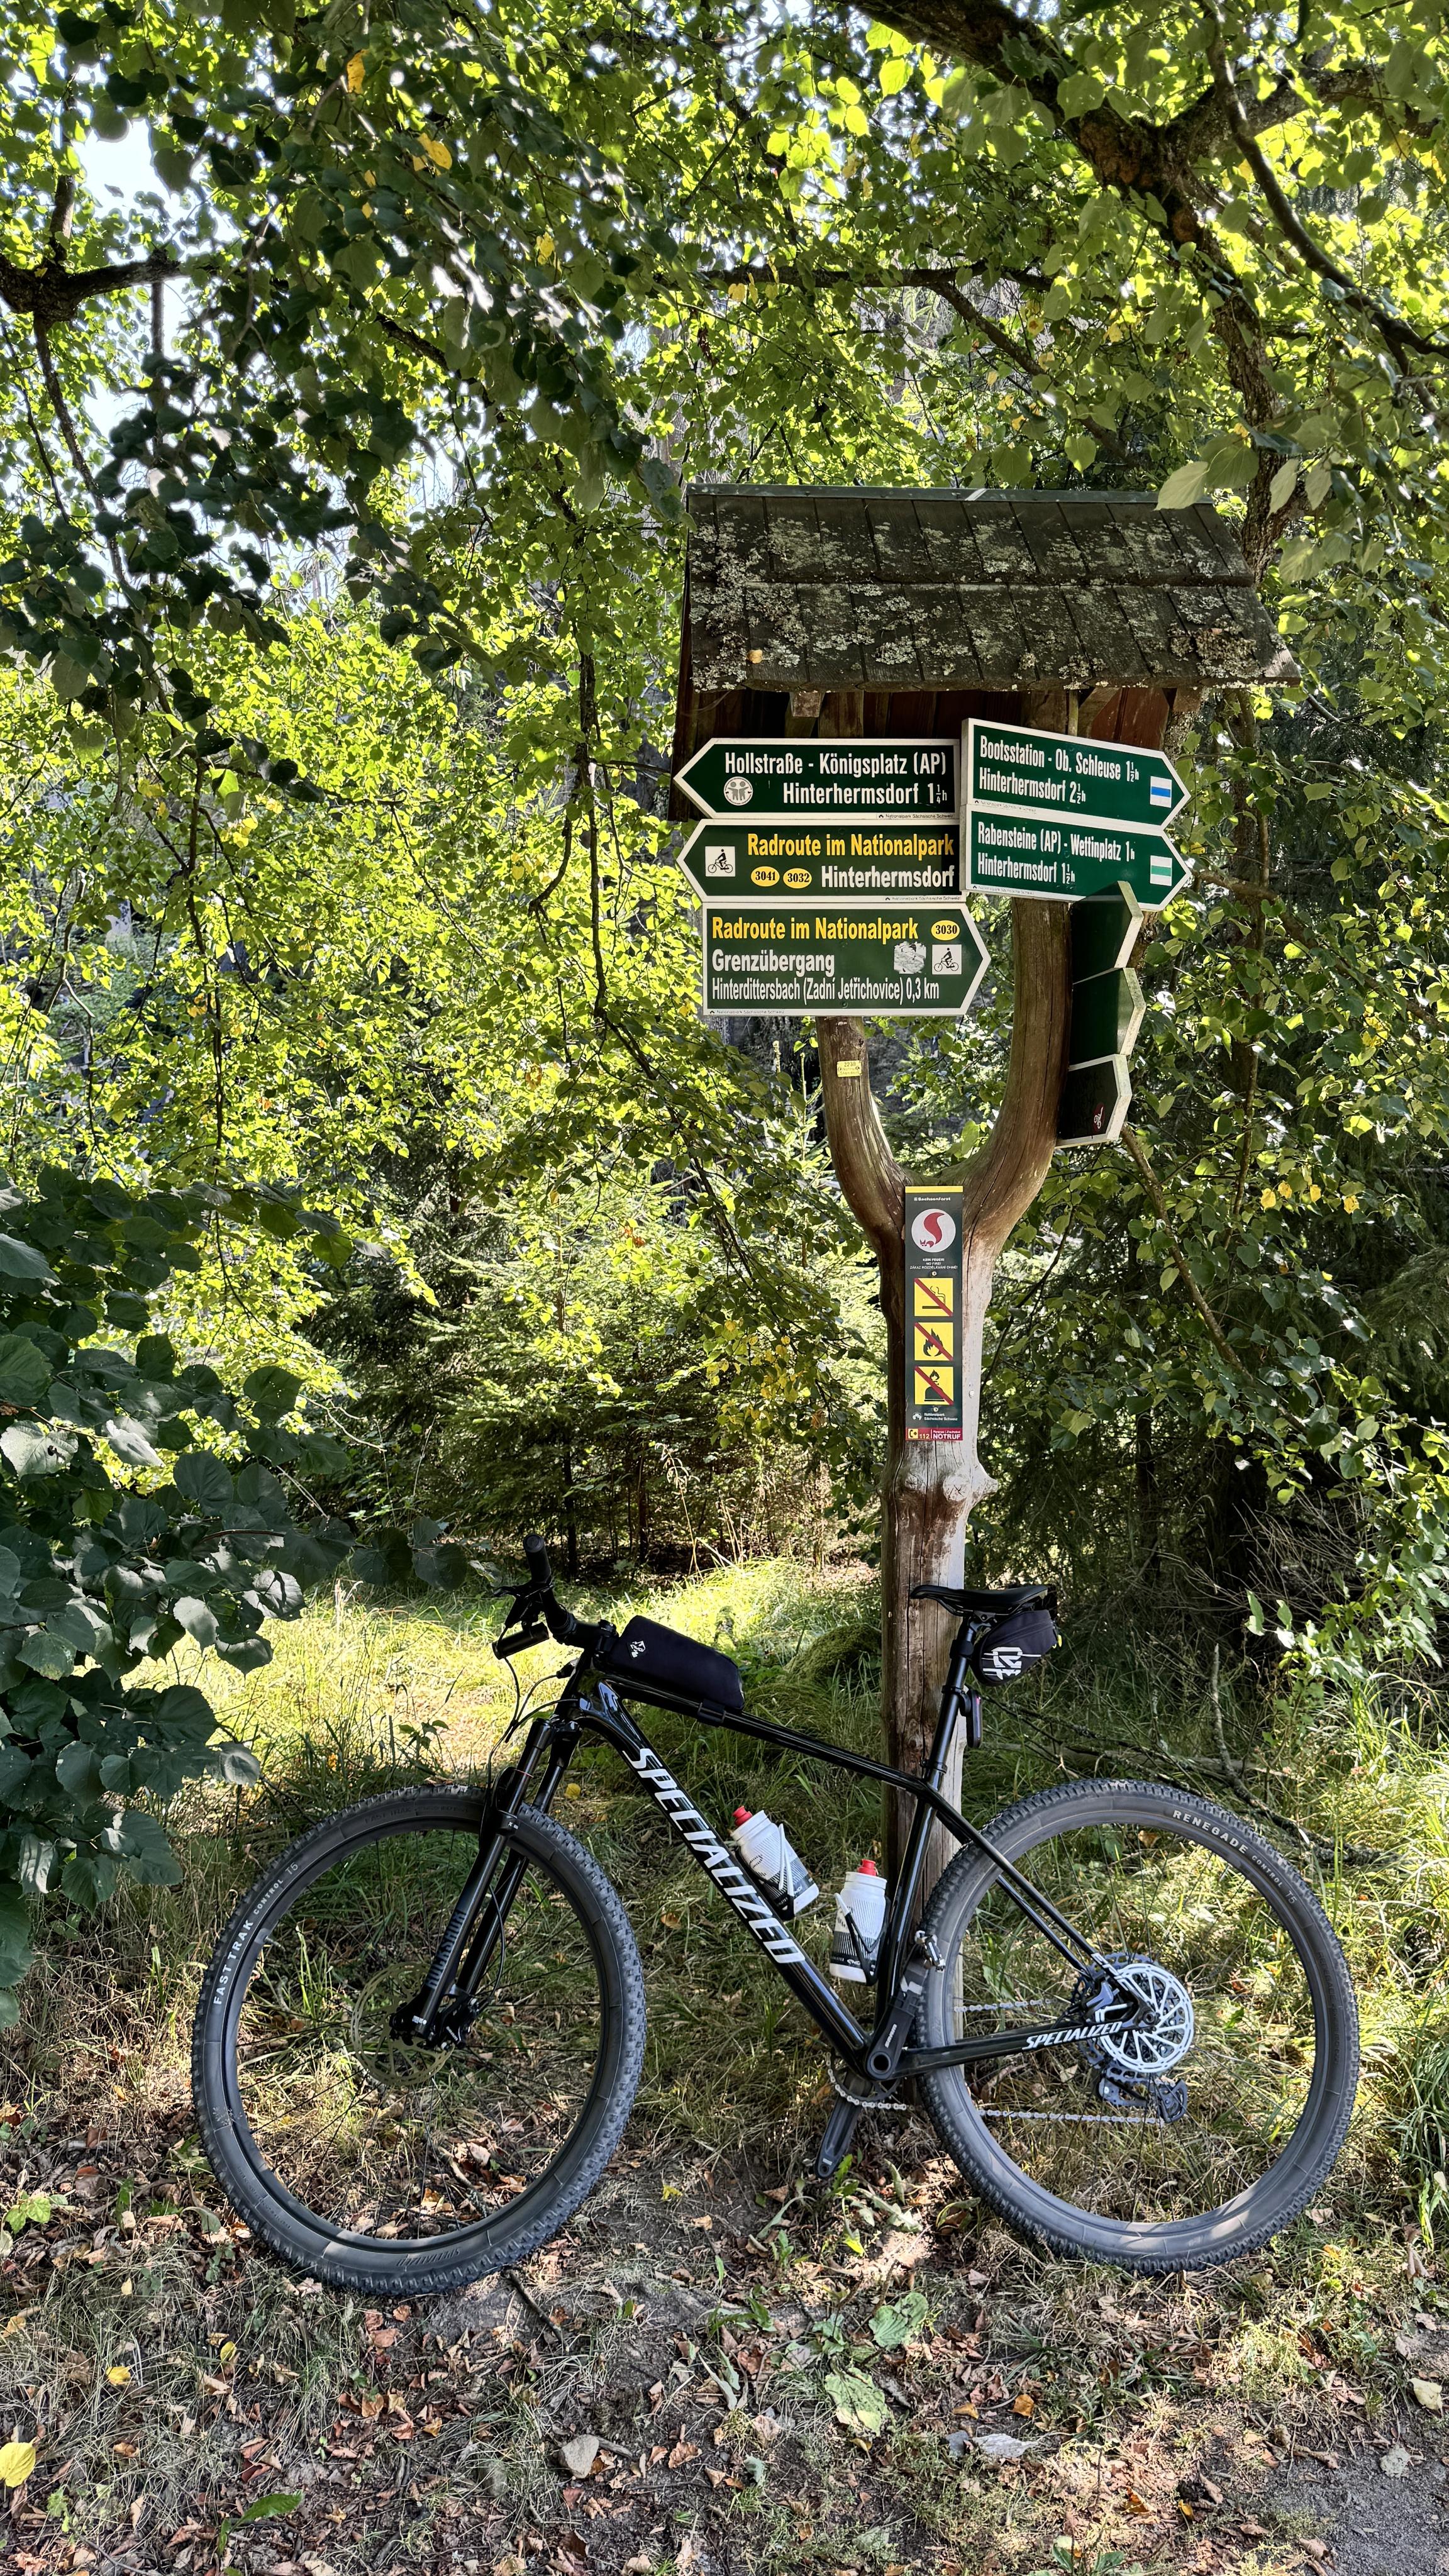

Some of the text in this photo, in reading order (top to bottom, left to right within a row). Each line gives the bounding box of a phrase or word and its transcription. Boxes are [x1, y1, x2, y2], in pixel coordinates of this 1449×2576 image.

[725, 752, 803, 774] Hollstraße
[820, 752, 908, 778] Königsplatz
[914, 752, 946, 775] (AP)
[980, 735, 1045, 768] Bootsstation
[1055, 748, 1072, 772] Ob.
[1076, 752, 1121, 780] Schleuse
[783, 782, 919, 804] Hinterhermsdorf
[979, 767, 1066, 802] Hinterhermsdorf
[748, 833, 954, 861] Radroute im Nationalpark
[978, 821, 1036, 850] Rabensteine
[1040, 828, 1061, 854] (AP)
[1070, 834, 1121, 862] Wettinplatz
[755, 871, 776, 882] 3041
[787, 873, 810, 883] 3032
[821, 865, 955, 888] Hinterhermsdorf
[978, 852, 1057, 883] Hinterhermsdorf
[712, 917, 918, 945] Radroute im Nationalpark
[935, 924, 957, 935] 3030
[712, 949, 835, 977] Grenzübergang
[713, 977, 940, 1005] Hinterdittersbach (Zadní Jetřichovice) 0,3 km
[623, 1748, 806, 1963] SPECIALIZED
[1172, 1809, 1297, 1904] RENEGADE CONTROL T5
[213, 1862, 299, 2005] FAST TRAK CONTROL T5
[1022, 2021, 1123, 2050] SPECIALIZED
